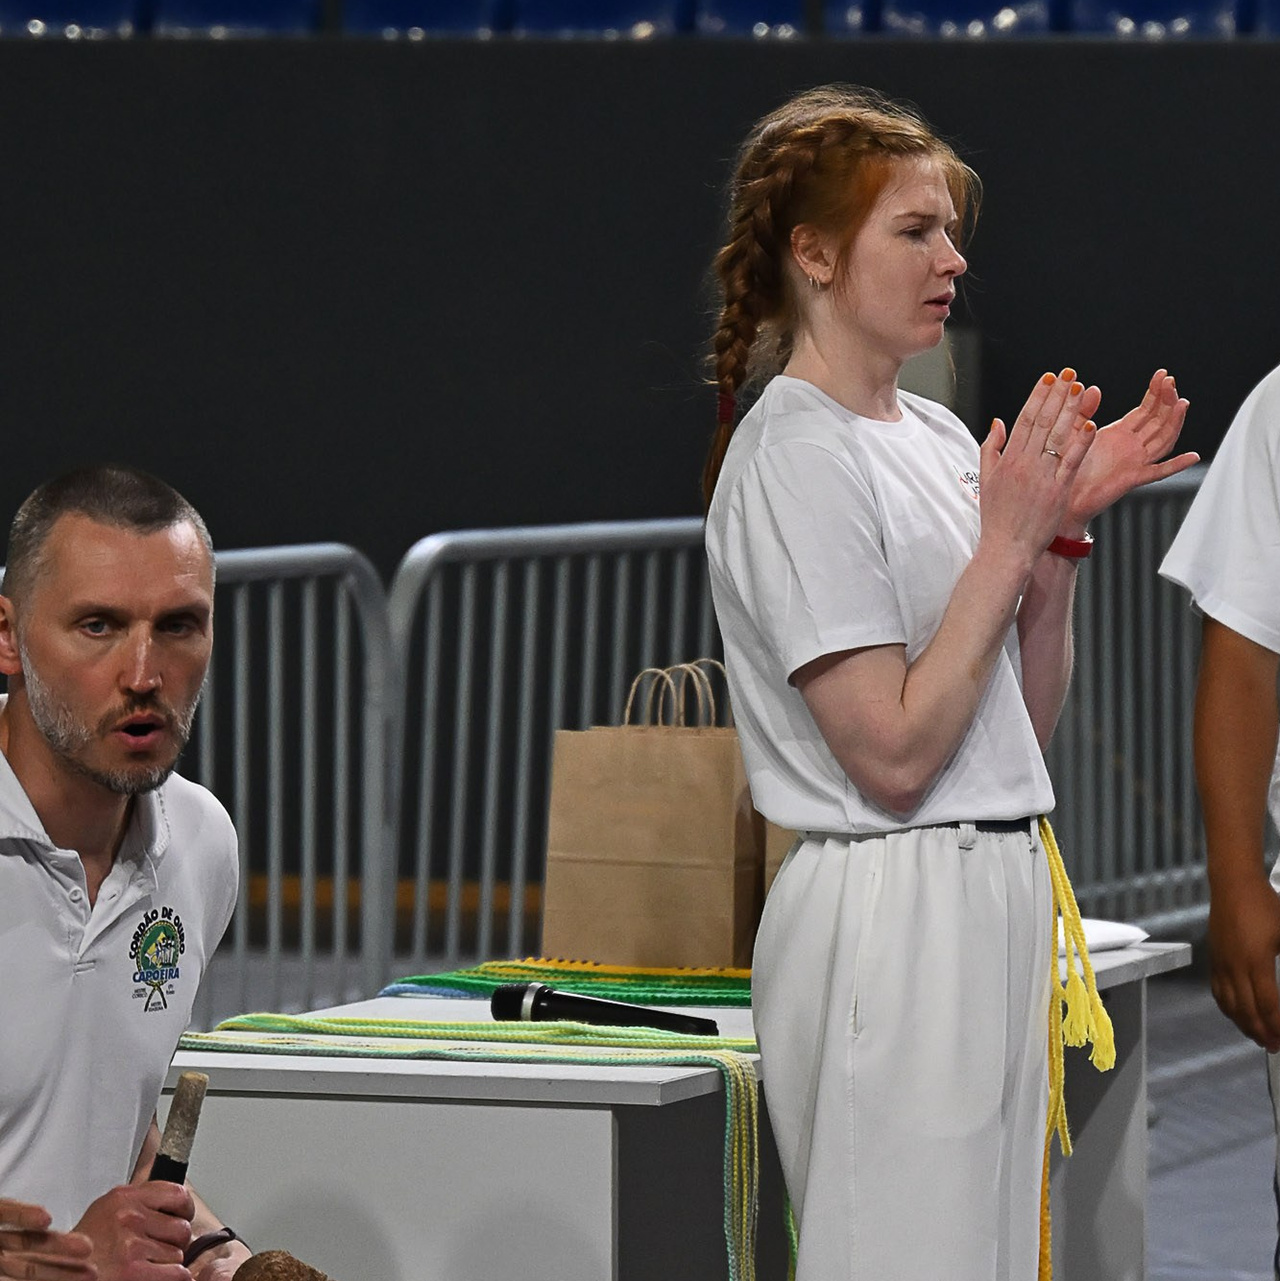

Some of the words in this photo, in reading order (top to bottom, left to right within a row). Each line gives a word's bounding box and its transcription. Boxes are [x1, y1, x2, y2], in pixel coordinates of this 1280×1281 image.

[129, 909, 159, 960] CORDÃO
[161, 906, 173, 921] DE
[174, 915, 185, 955] OURO
[132, 967, 180, 983] CAPOEIRA
